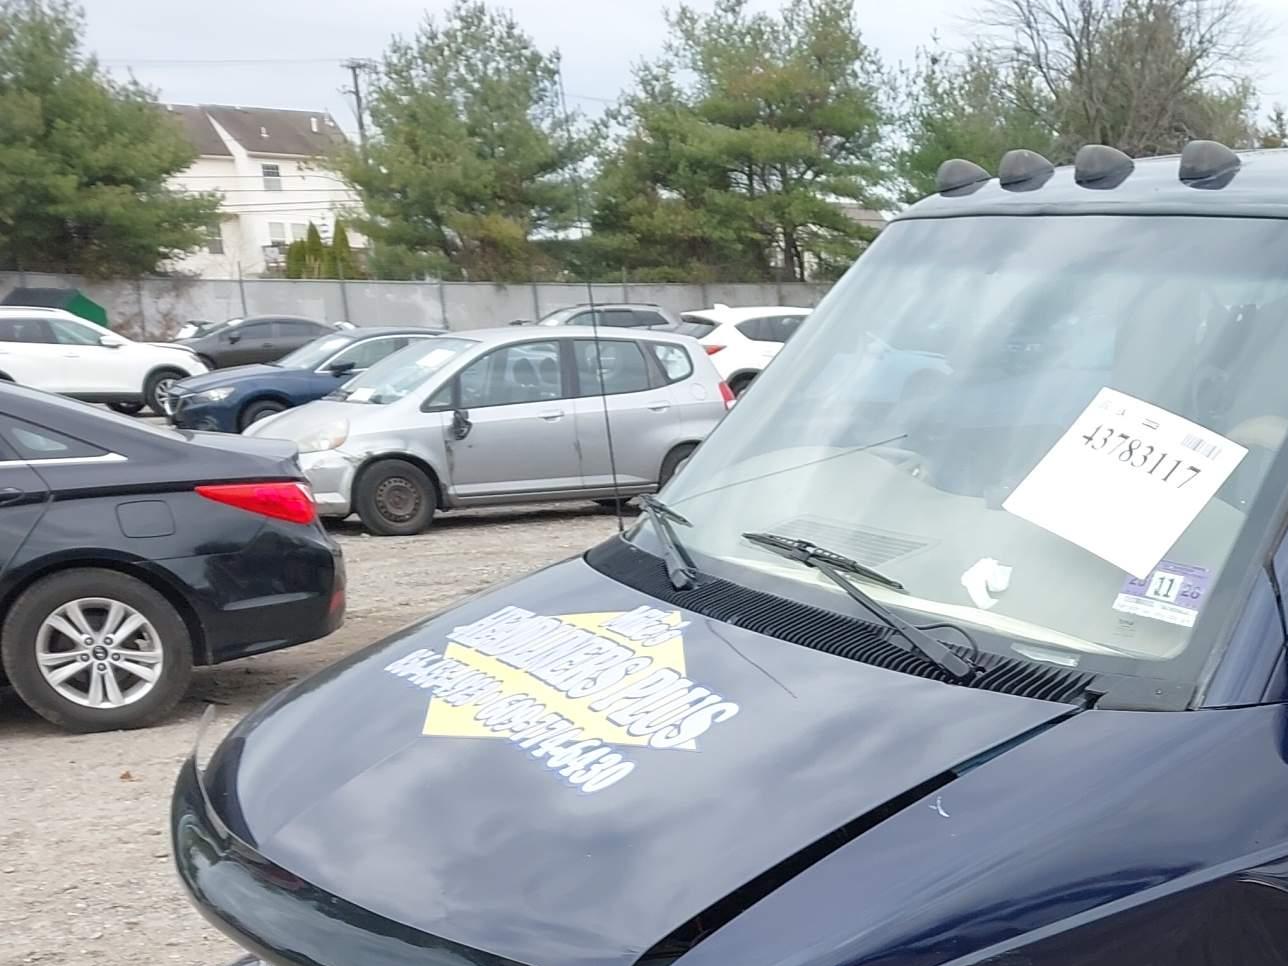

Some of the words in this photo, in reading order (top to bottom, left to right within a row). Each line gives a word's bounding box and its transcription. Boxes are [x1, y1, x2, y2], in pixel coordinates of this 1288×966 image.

[1082, 424, 1202, 489] 43783117
[1153, 576, 1176, 598] 11
[588, 667, 740, 750] PLUS
